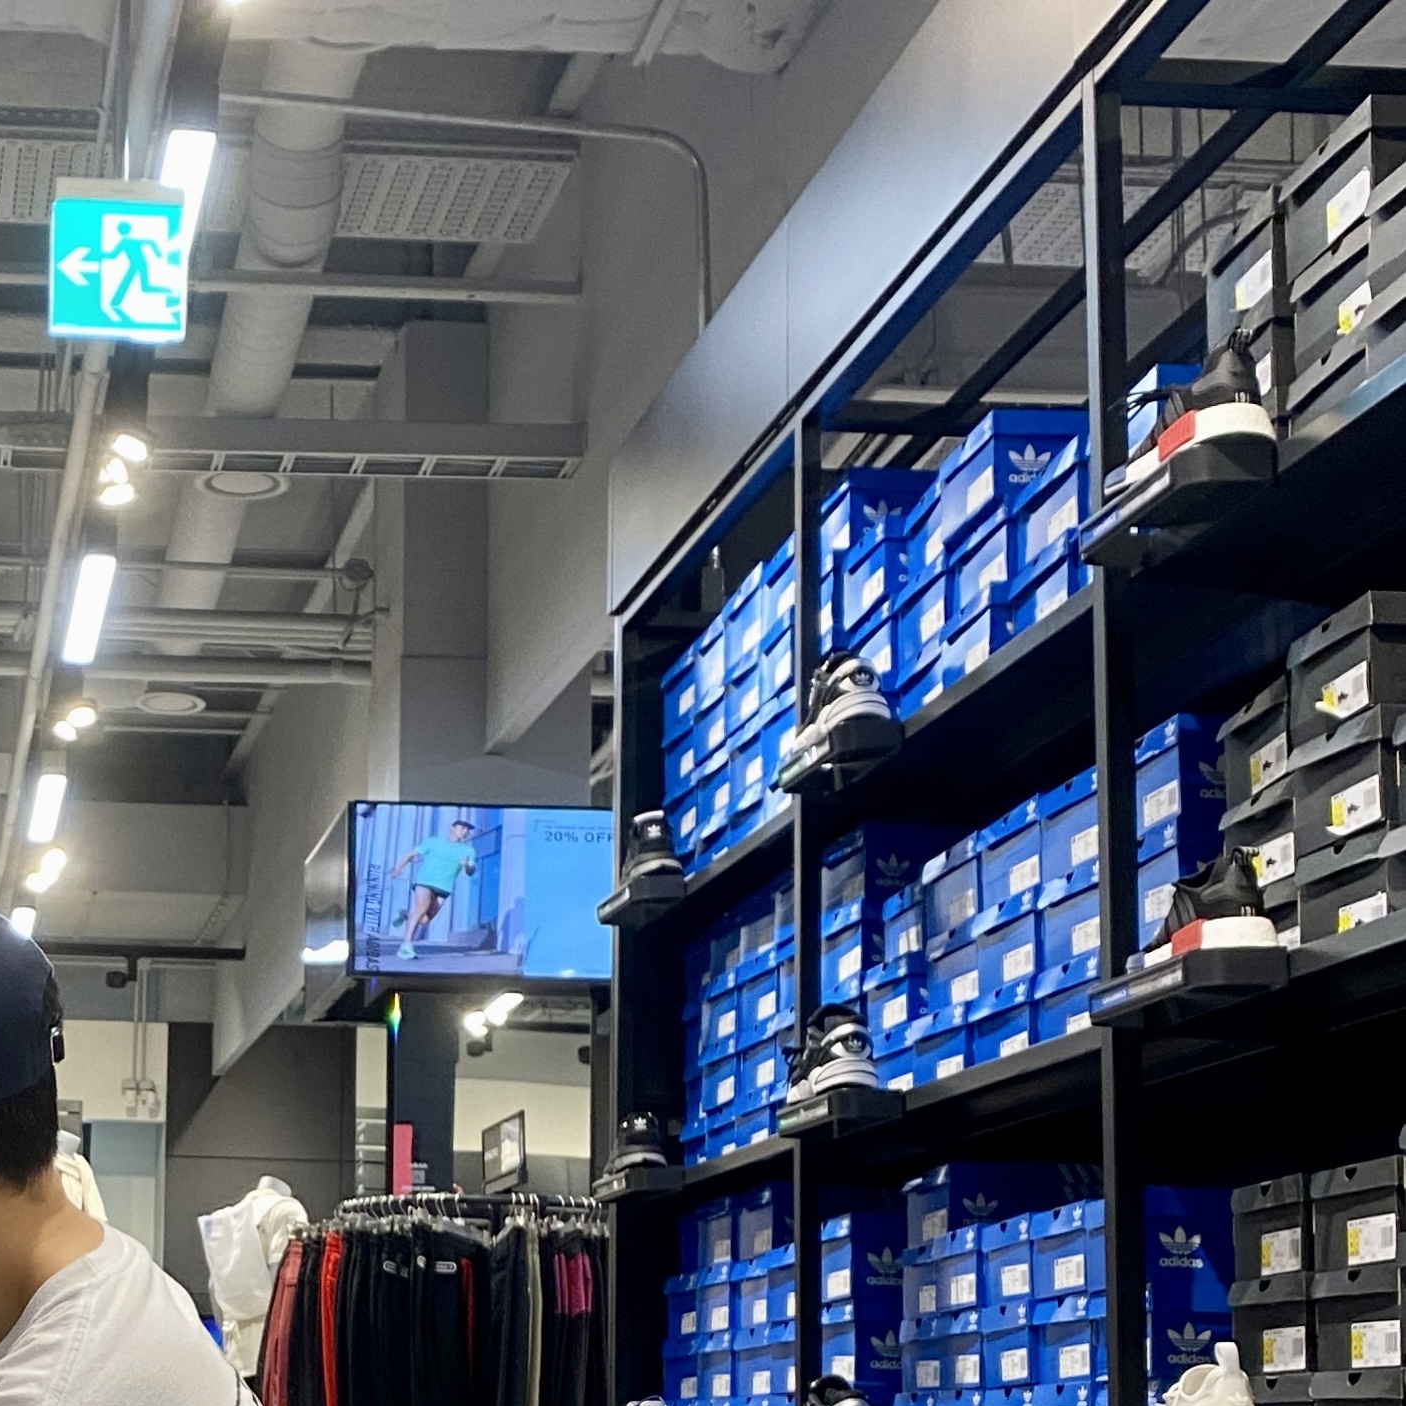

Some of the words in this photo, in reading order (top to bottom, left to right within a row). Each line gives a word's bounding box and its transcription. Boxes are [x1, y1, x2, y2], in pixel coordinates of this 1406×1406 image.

[544, 830, 579, 843] 20%
[1159, 1256, 1204, 1269] adidas
[866, 1275, 903, 1286] adida
[1167, 1353, 1211, 1365] adidas
